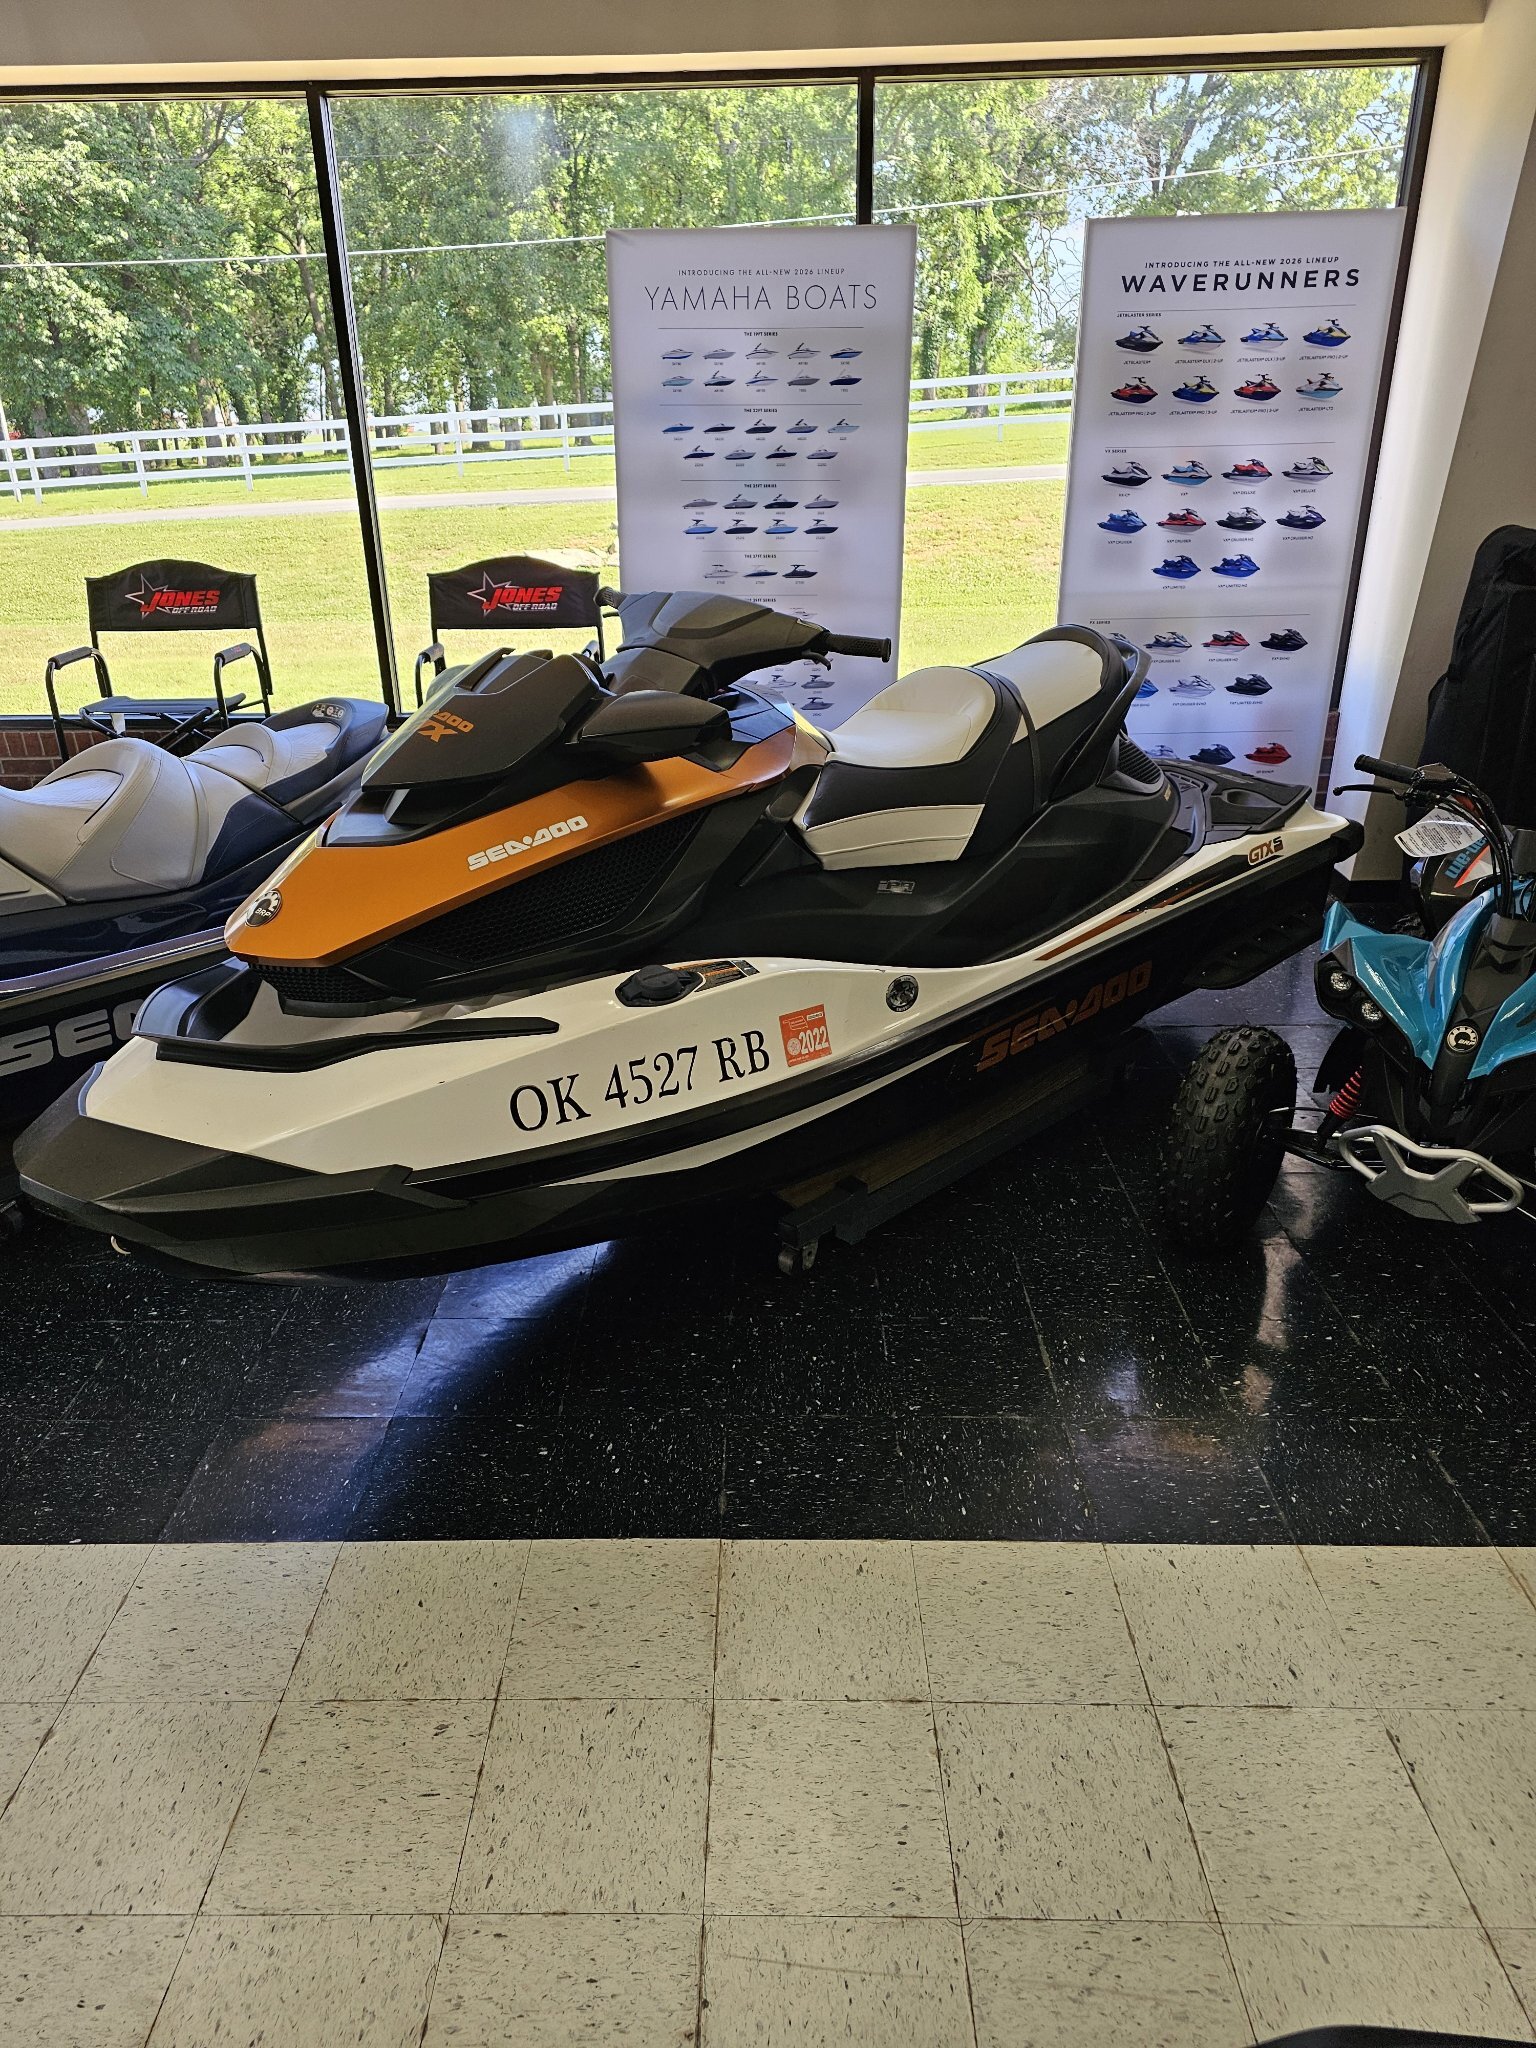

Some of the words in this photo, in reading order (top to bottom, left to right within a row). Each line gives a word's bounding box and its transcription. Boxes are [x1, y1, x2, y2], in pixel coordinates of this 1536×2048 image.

[1145, 261, 1209, 269] INTRODUCING
[1234, 258, 1276, 267] ALL-NEW
[1280, 257, 1302, 265] 2026
[1306, 256, 1340, 264] LINEUP
[1121, 268, 1360, 293] WAVERUNNERS
[644, 285, 772, 311] YAMAHA
[786, 284, 877, 310] BOATS
[140, 589, 220, 613] JONES
[171, 606, 190, 614] OFF
[190, 605, 218, 613] ROAD
[481, 586, 563, 611] JONES
[512, 602, 531, 611] OFF
[531, 602, 558, 610] ROAD
[254, 907, 272, 917] BRP
[799, 1025, 830, 1055] 2022
[1457, 1038, 1476, 1046] BRP
[509, 1073, 592, 1132] OK
[604, 1045, 698, 1109] 4527
[711, 1029, 771, 1083] RB
